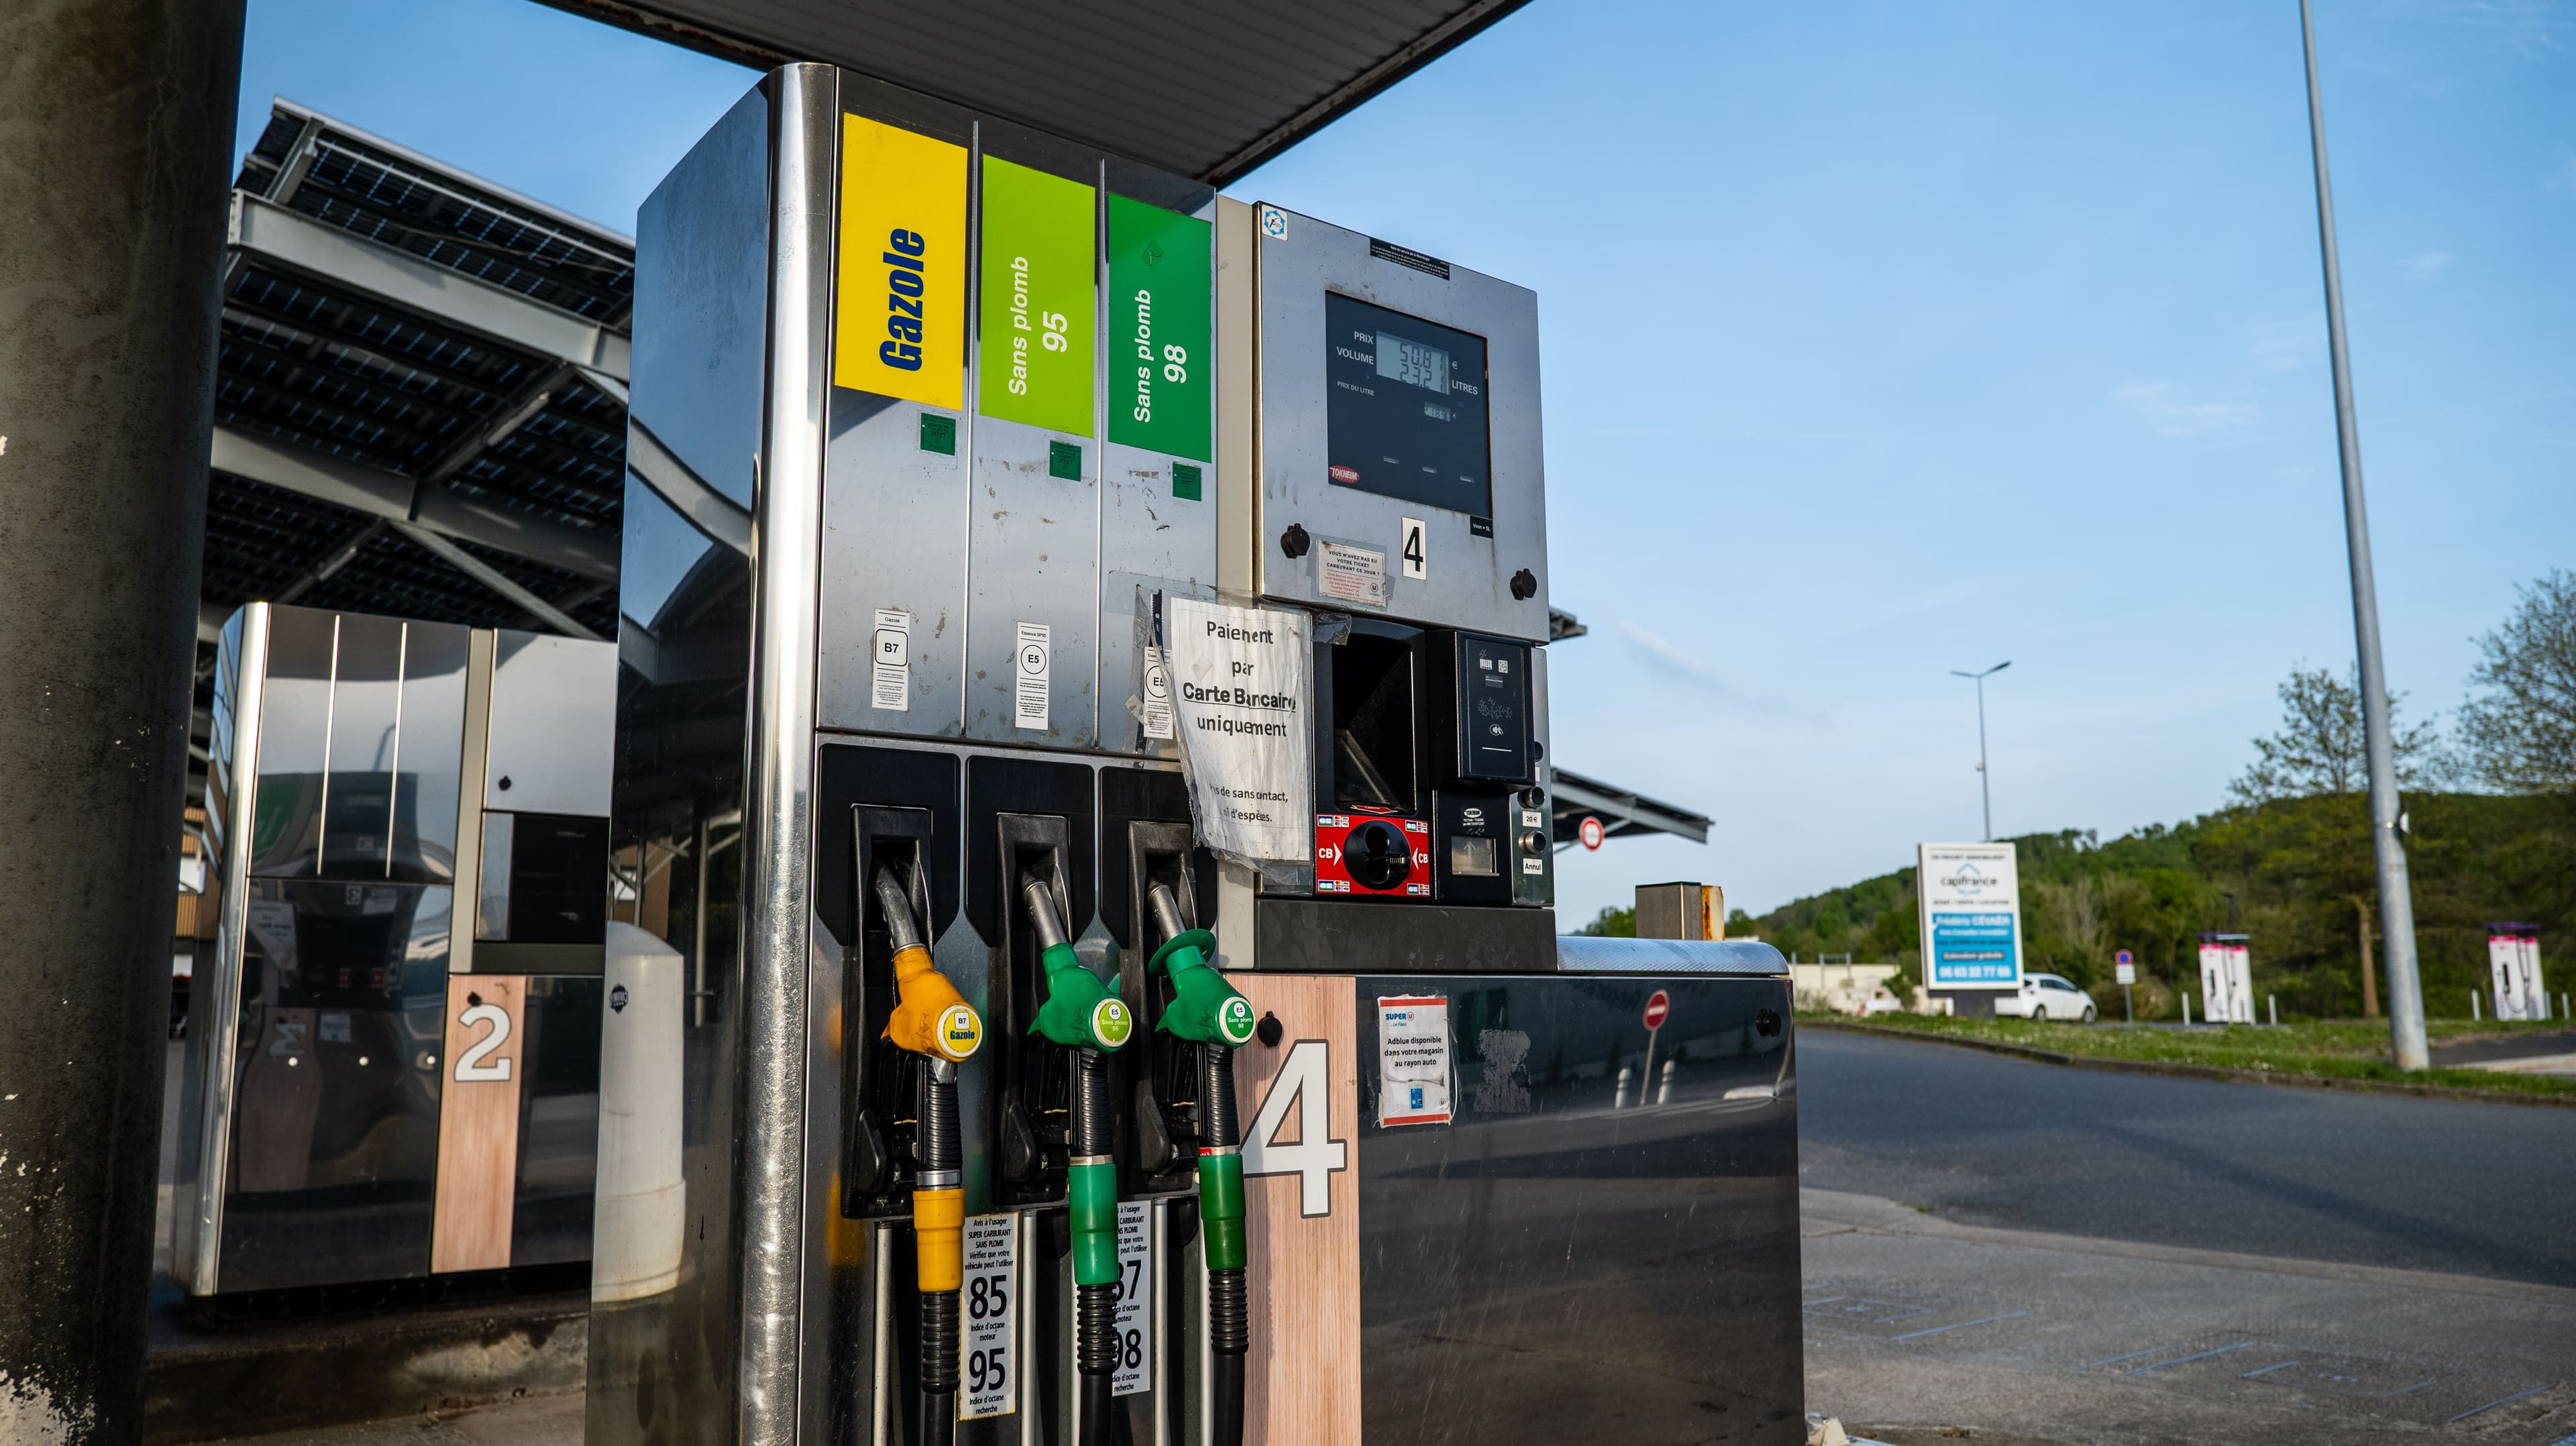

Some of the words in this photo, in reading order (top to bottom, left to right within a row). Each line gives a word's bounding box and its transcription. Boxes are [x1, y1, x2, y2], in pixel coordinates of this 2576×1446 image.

[1010, 256, 1032, 331] plomb
[879, 228, 926, 372] Gazole
[1134, 289, 1155, 362] plomb
[1042, 311, 1068, 353] 95
[1354, 331, 1374, 345] PRIX
[1336, 346, 1375, 365] VOLUME
[1008, 337, 1027, 396] Sans
[1164, 344, 1187, 384] 98
[1452, 361, 1458, 370] €
[1337, 381, 1350, 390] PRIX
[1360, 388, 1375, 396] LITRE
[1452, 380, 1478, 396] LITRES
[1134, 367, 1151, 423] Sans
[1329, 467, 1358, 481] TOKHEIM
[1403, 526, 1424, 572] 4
[1326, 563, 1355, 571] CARBURANT
[884, 643, 899, 653] B7
[1028, 654, 1039, 664] E5
[1183, 682, 1230, 703] Carte
[1197, 714, 1287, 737] uniquement
[1220, 785, 1230, 797] de
[1232, 789, 1255, 799] sans
[1318, 847, 1333, 858] CB
[1418, 852, 1428, 864] CB
[1525, 863, 1541, 871] Annul
[1940, 875, 1998, 887] capifrance
[1385, 1012, 1407, 1021] SUPER
[950, 1030, 975, 1040] Gazole
[453, 1002, 512, 1082] 2
[1387, 1037, 1409, 1045] Adblue
[1411, 1036, 1442, 1046] disponible
[1418, 1047, 1444, 1056] magasin
[1240, 1039, 1348, 1219] 4
[1124, 1205, 1141, 1214] l'usager
[984, 1218, 988, 1226] à
[989, 1218, 1008, 1227] l'usager
[1119, 1216, 1144, 1225] CARBURANT
[968, 1231, 983, 1239] SUPER
[983, 1229, 1012, 1238] CARBURANT
[1124, 1226, 1138, 1234] PLOMB
[975, 1240, 987, 1249] SANS
[989, 1239, 1004, 1247] PLOMB
[1123, 1237, 1132, 1245] que
[969, 1251, 987, 1260] Vérifiez
[987, 1252, 996, 1260] que
[998, 1249, 1010, 1258] votre
[1120, 1246, 1130, 1256] peut
[1131, 1245, 1148, 1253] l'utiliser
[965, 1262, 983, 1271] véhicule
[984, 1261, 995, 1270] peut
[996, 1260, 1014, 1268] l'utiliser
[969, 1274, 1008, 1319] 85
[1122, 1304, 1140, 1313] d'octane
[1117, 1315, 1132, 1323] moteur
[971, 1323, 984, 1332] Indice
[985, 1321, 1005, 1330] d'octane
[979, 1333, 996, 1342] moteur
[969, 1347, 1006, 1393] 95
[1122, 1373, 1140, 1382] d'octane
[1114, 1383, 1134, 1392] recherche
[969, 1396, 983, 1406] Indice
[983, 1394, 1004, 1403] d'octane
[975, 1405, 998, 1414] recherche
